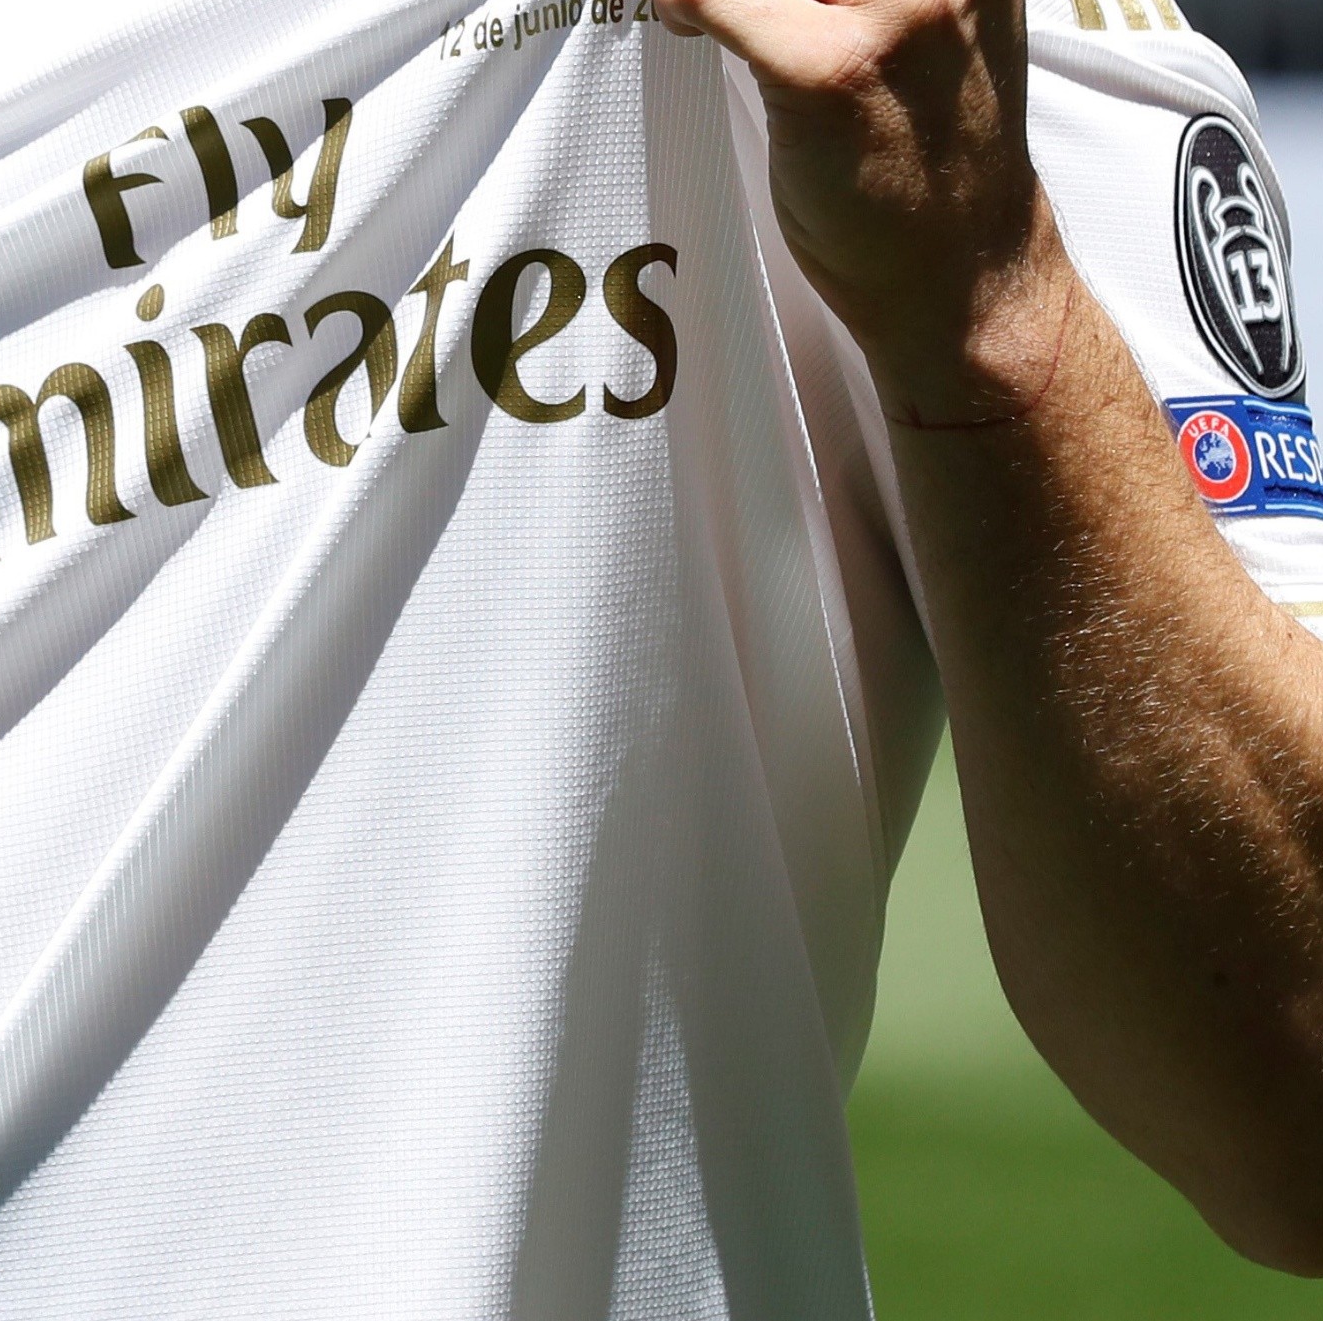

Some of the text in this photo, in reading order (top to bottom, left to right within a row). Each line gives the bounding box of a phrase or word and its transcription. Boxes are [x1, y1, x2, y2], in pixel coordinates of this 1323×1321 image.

[439, 18, 465, 61] 12
[473, 11, 504, 50] de
[82, 96, 354, 270] Fly
[1228, 247, 1282, 323] 13
[1187, 416, 1230, 438] UEFA
